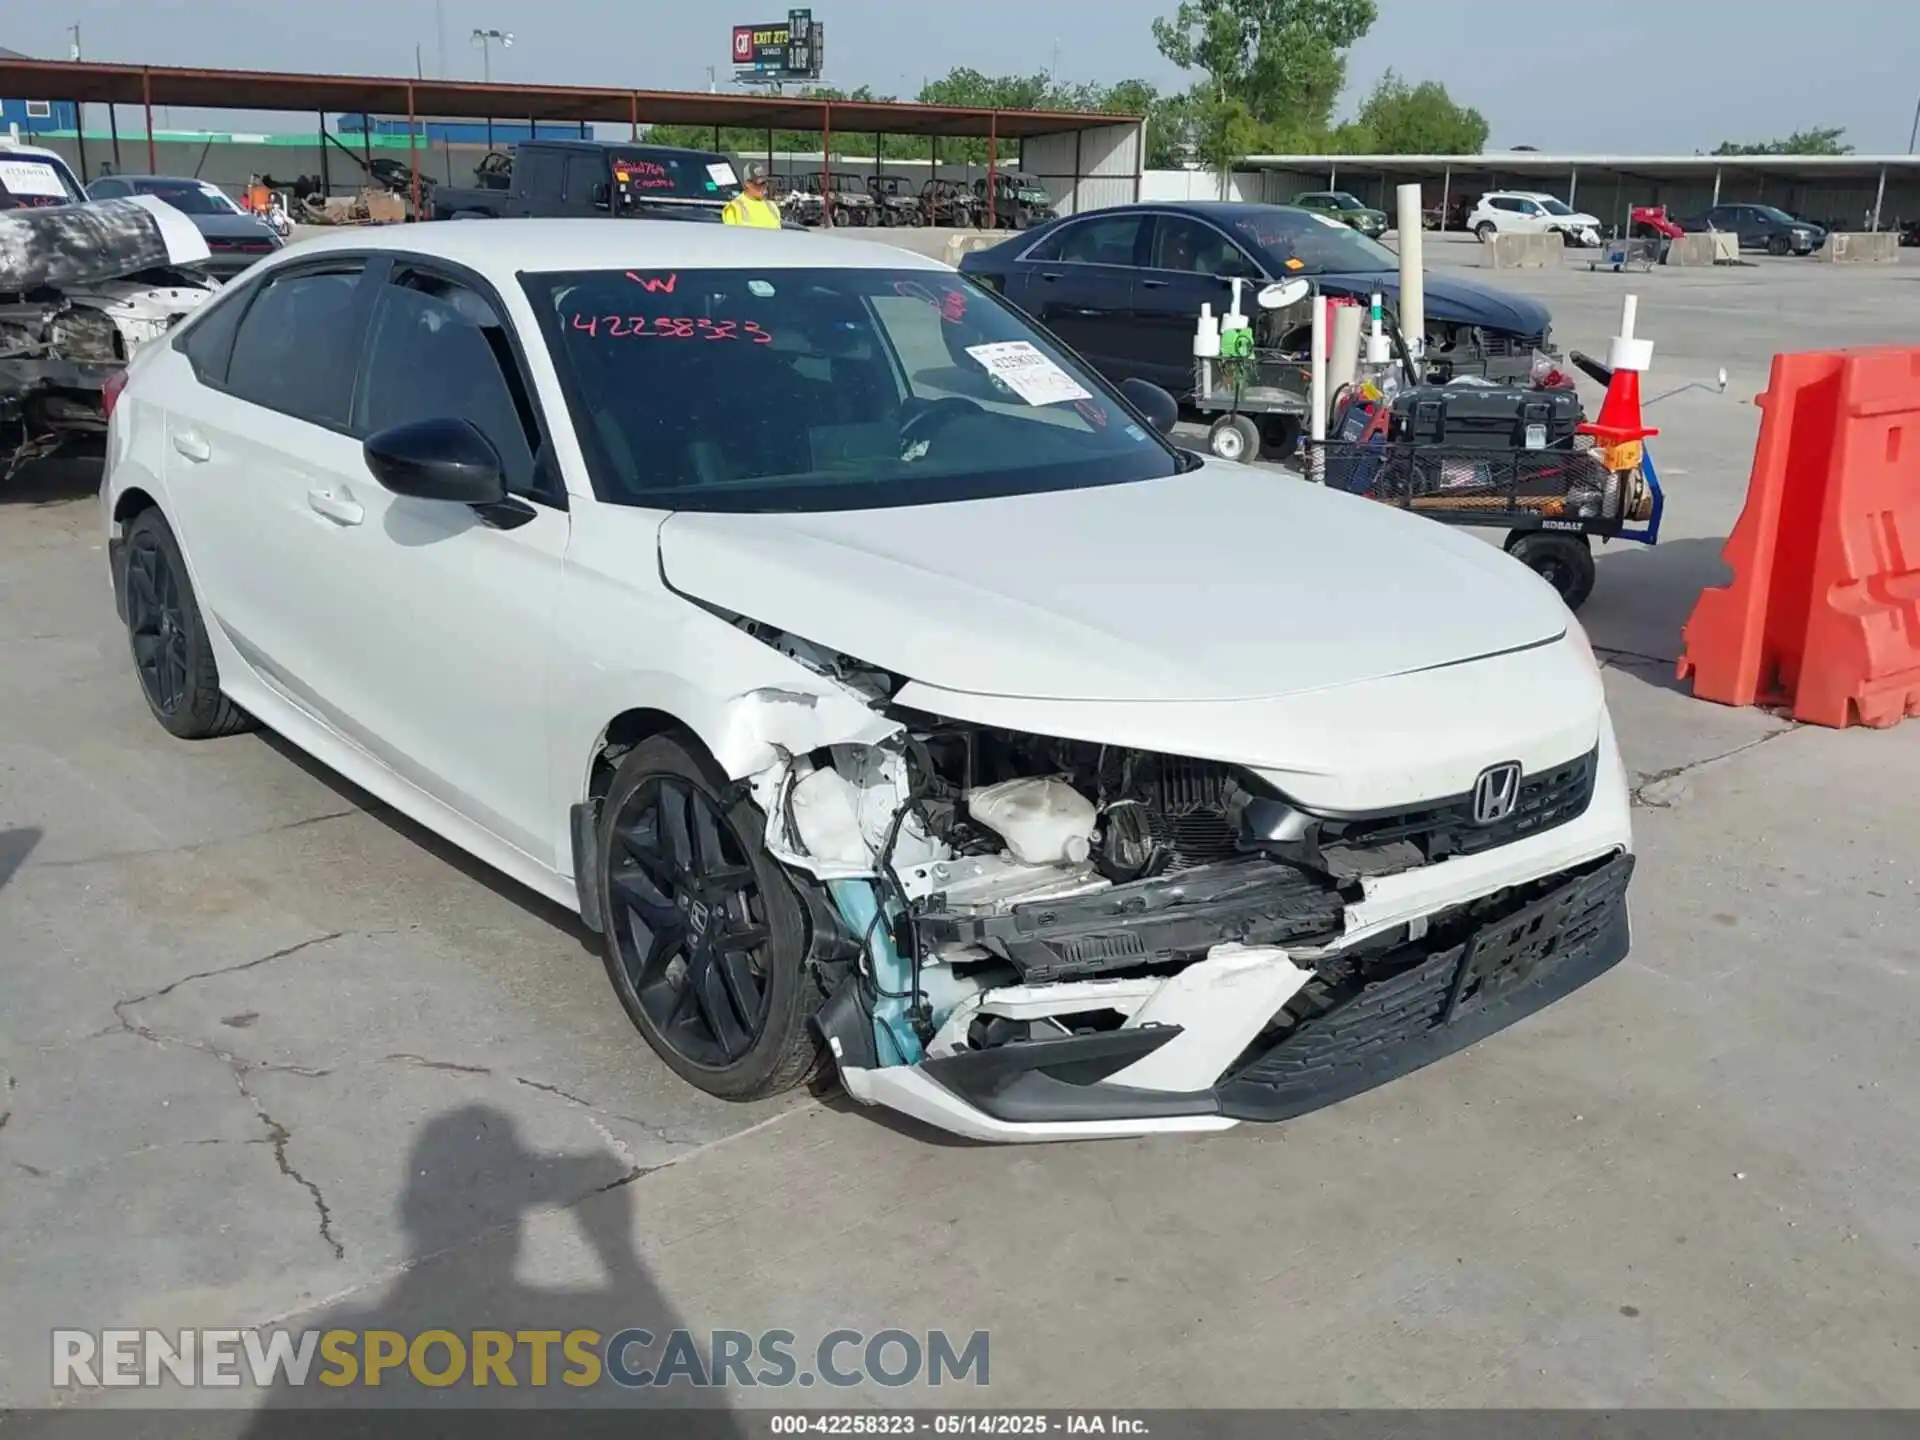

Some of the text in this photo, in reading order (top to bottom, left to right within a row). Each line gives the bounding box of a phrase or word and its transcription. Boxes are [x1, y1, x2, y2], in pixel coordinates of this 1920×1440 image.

[735, 33, 749, 54] QT
[753, 29, 789, 45] EXIT 273
[626, 271, 677, 293] W
[573, 313, 772, 343] 42258323
[1542, 519, 1584, 531] KOBALT
